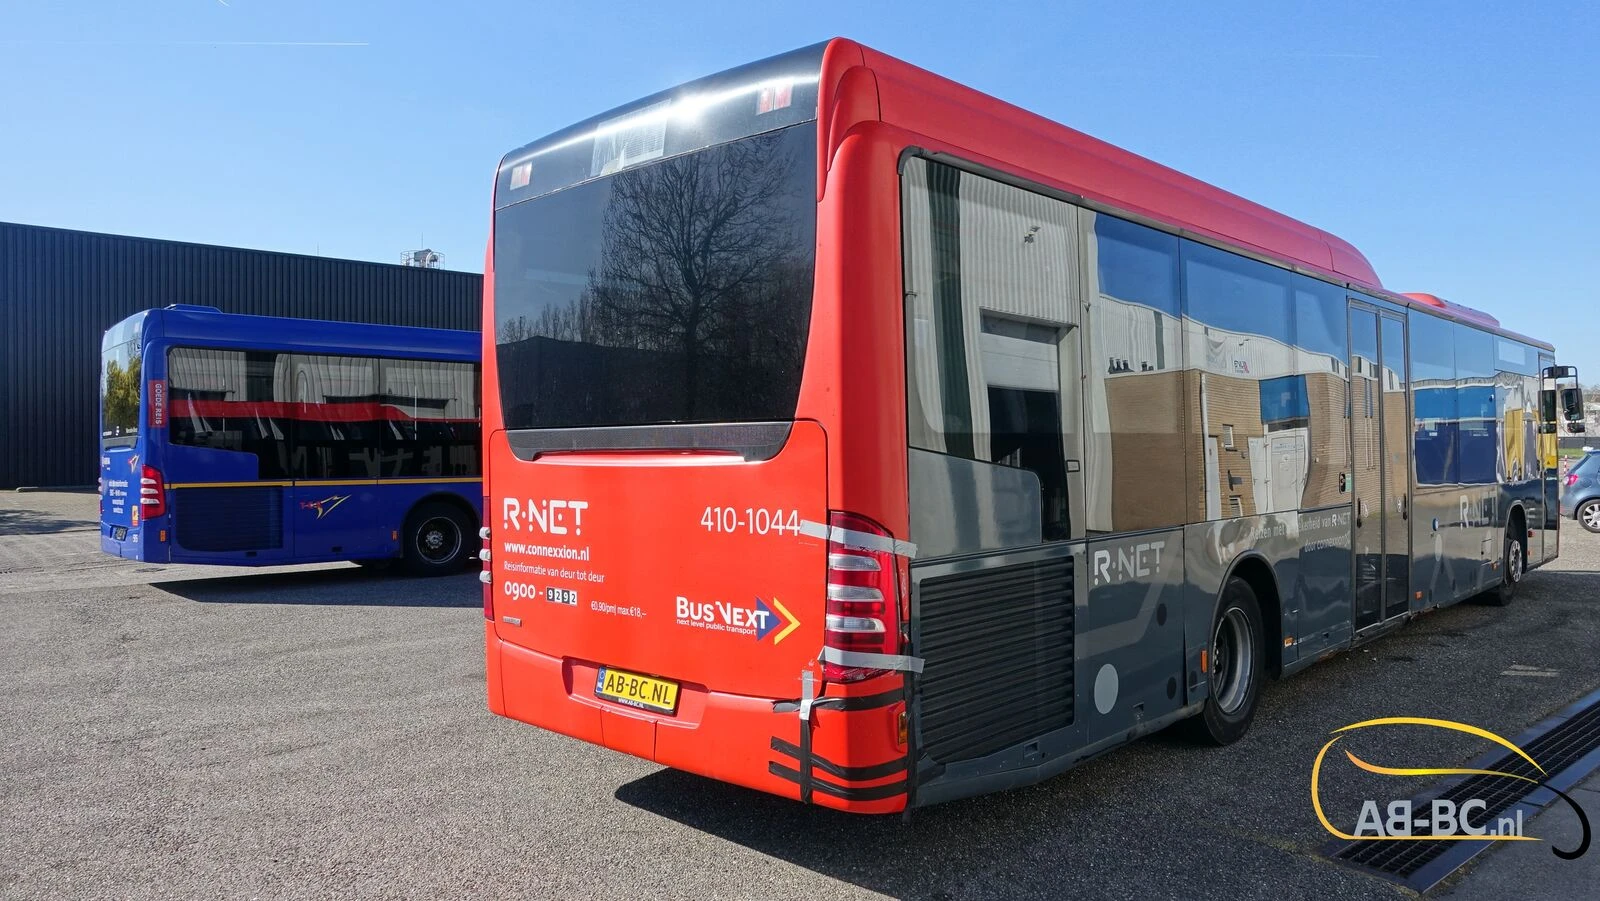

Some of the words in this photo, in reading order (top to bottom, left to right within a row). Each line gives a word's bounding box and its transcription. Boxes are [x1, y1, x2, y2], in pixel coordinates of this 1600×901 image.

[155, 383, 163, 407] GOEDE
[155, 408, 163, 425] REIS
[700, 506, 801, 537] 410-1044
[504, 541, 590, 561] www.connexxion.nl
[503, 560, 546, 575] Reisinformatie
[547, 567, 559, 577] van
[560, 567, 576, 579] deur
[576, 570, 587, 581] tot
[587, 571, 605, 583] deur
[504, 580, 536, 601] 0900
[547, 588, 577, 604] 9292
[676, 618, 690, 626] next
[690, 619, 705, 628] level
[705, 621, 725, 631] public
[726, 625, 757, 636] transport
[605, 673, 671, 705] AB-BC.NL
